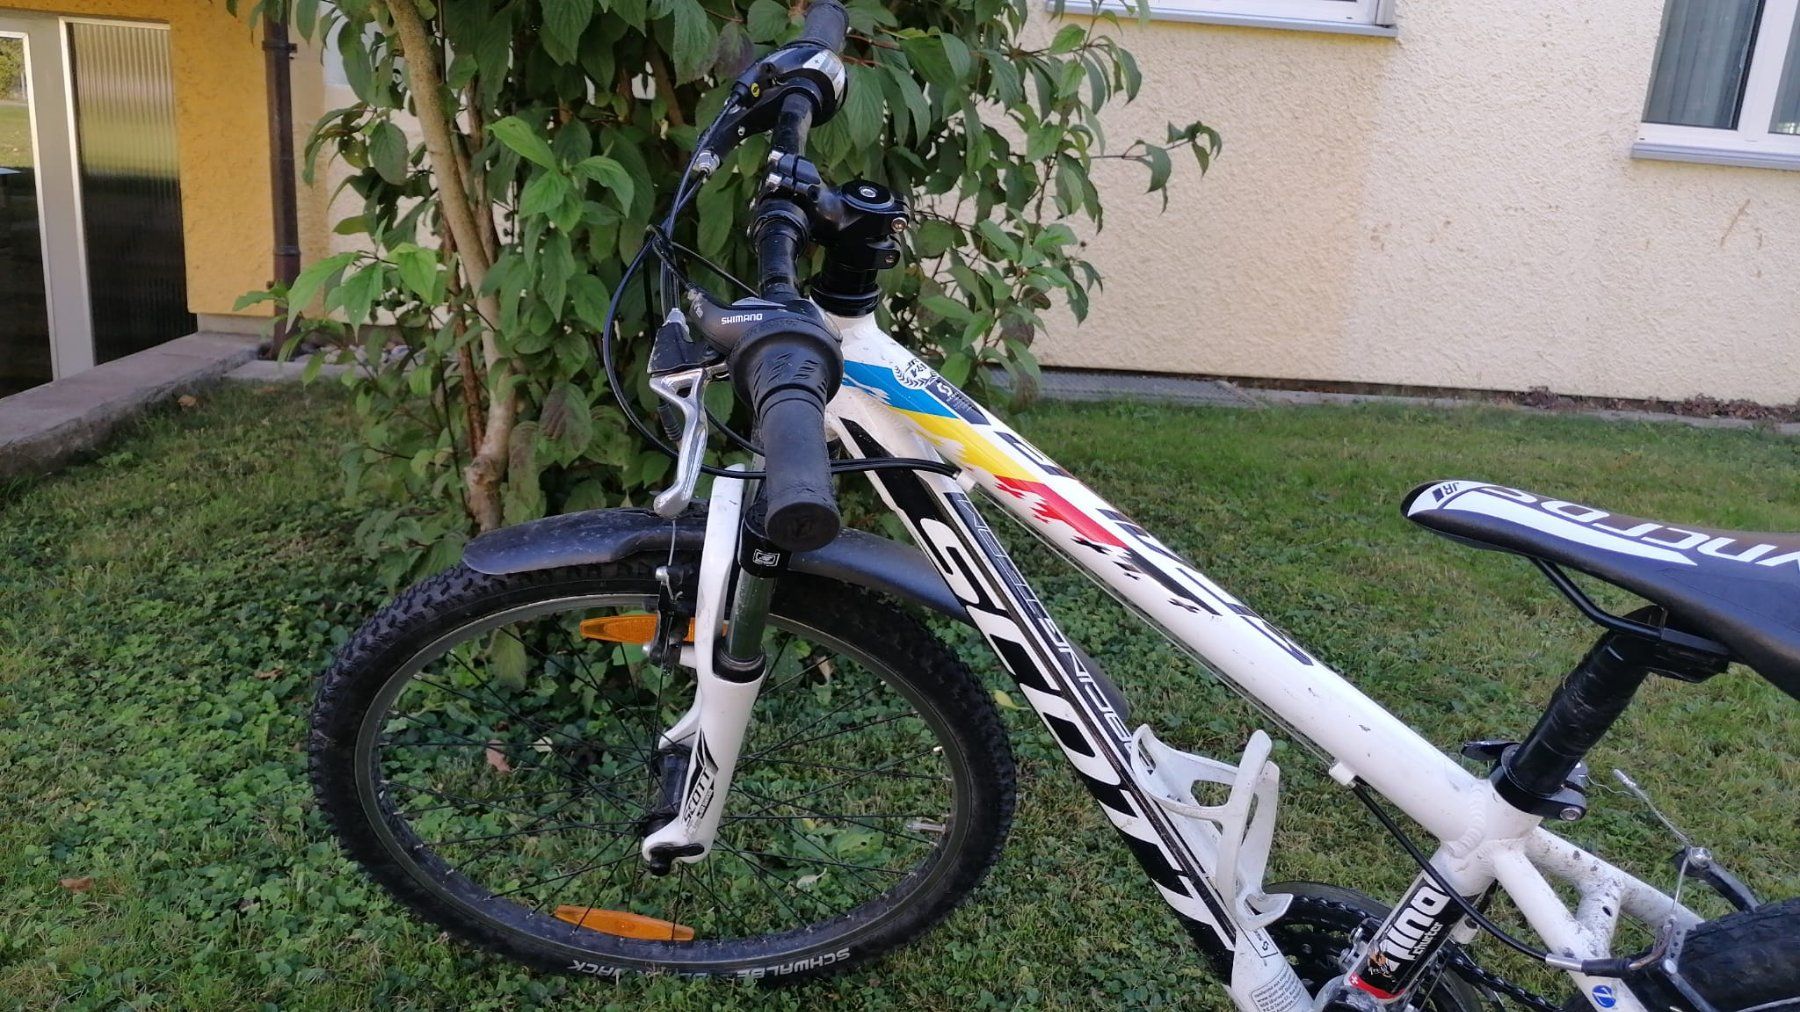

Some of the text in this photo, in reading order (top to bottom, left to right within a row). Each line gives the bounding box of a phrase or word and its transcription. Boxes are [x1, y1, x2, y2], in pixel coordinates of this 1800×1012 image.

[721, 313, 763, 325] SHIMANO
[920, 517, 1236, 951] SCOTT
[682, 766, 710, 829] SCOTT
[736, 947, 851, 979] SCHWALBE
